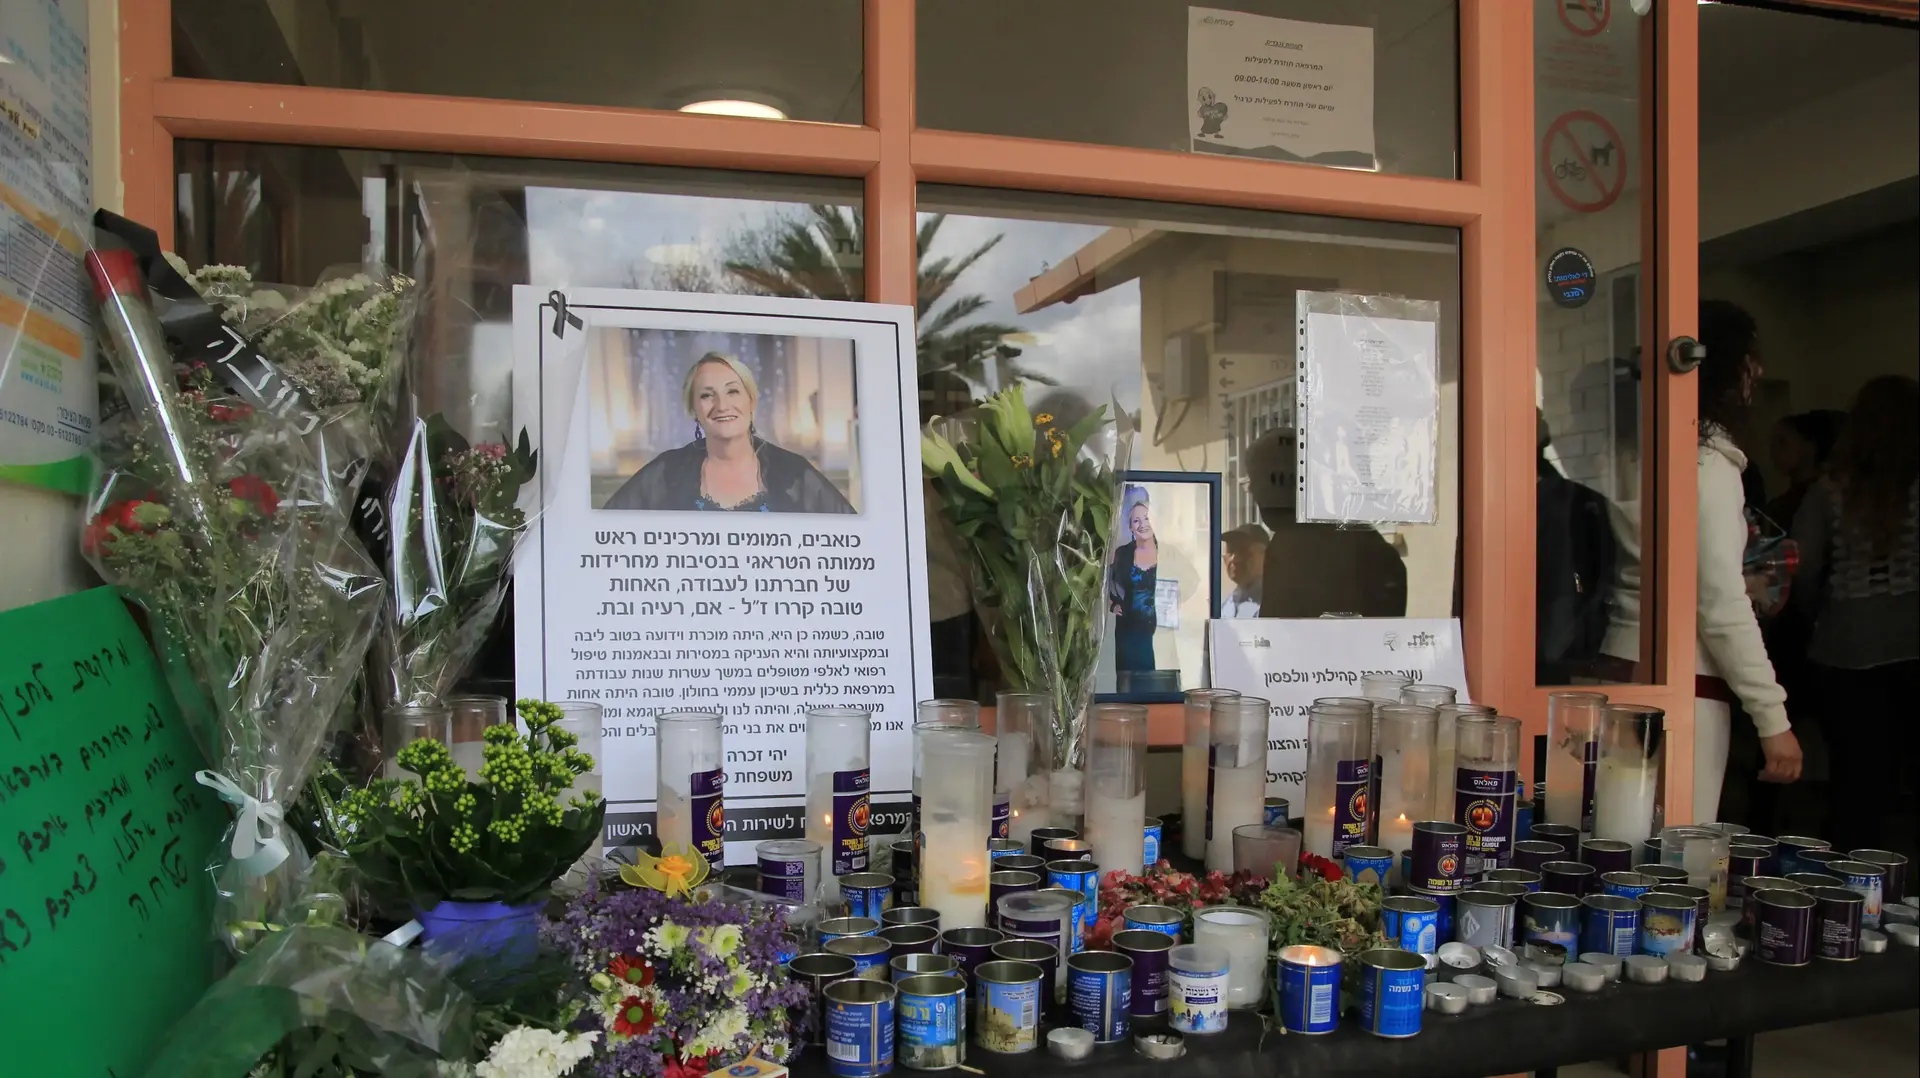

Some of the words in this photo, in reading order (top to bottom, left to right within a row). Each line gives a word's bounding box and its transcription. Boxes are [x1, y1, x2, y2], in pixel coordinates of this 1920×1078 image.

[1245, 55, 1272, 65] לפעילות
[1274, 59, 1294, 67] חוזרת
[1295, 62, 1323, 71] המרפאה
[1234, 74, 1280, 86] 09:00-14:00
[1281, 80, 1301, 88] משעה
[1303, 82, 1322, 91] ראשון
[1254, 96, 1282, 105] לפעילות
[596, 531, 636, 544] ראש
[644, 532, 720, 545] ומרכינים
[728, 533, 791, 546] המומים
[798, 534, 860, 548] כואבים,
[580, 555, 658, 568] מחרידות
[666, 555, 739, 568] בנסיבות
[747, 556, 810, 569] הטראגי
[818, 557, 875, 570] ממותה
[609, 578, 669, 591] האחות
[677, 575, 747, 594] לעבודה,
[755, 579, 818, 592] חברתנו
[825, 575, 850, 592] של
[597, 602, 633, 615] ובת.
[642, 602, 684, 615] רעיה
[691, 602, 722, 617] אם,
[775, 602, 814, 619] קררו
[821, 602, 862, 615] טובה
[575, 629, 604, 641] ליבה
[610, 631, 641, 641] בטוב
[646, 631, 683, 640] וידועה
[689, 631, 728, 640] מוכרת
[733, 631, 764, 640] היתה
[768, 631, 792, 641] היא,
[797, 631, 808, 643] כן
[813, 631, 848, 640] כשמה
[853, 631, 884, 641] טובה,
[571, 648, 607, 660] טיפול
[612, 650, 671, 660] ובנאמנות
[676, 650, 730, 659] במסירות
[735, 649, 779, 661] העניקה
[785, 649, 809, 658] והיא
[814, 649, 888, 660] ובמקצועיותה
[576, 670, 626, 680] עבודתה
[632, 669, 663, 679] שנות
[668, 669, 710, 678] עשרות
[715, 668, 752, 680] במשך
[757, 665, 809, 677] מטופלים
[814, 664, 849, 676] לאלפי
[854, 667, 885, 676] רפואי
[1264, 669, 1309, 689] וולפסון
[1312, 669, 1358, 686] קהילתי
[567, 689, 600, 699] אחות
[605, 689, 637, 698] היתה
[643, 688, 674, 698] טובה
[679, 685, 719, 700] בחולון.
[724, 687, 755, 696] עממי
[761, 686, 798, 698] בשיכון
[804, 683, 839, 695] כללית
[843, 685, 895, 694] במרפאת
[626, 706, 665, 717] דוגמא
[732, 702, 750, 715] לנו
[755, 704, 789, 715] והיתה
[626, 723, 656, 737] בלים
[743, 724, 761, 734] בני
[766, 723, 784, 733] את
[886, 721, 904, 731] אנו
[1267, 738, 1300, 751] והצוו
[727, 750, 763, 762] זכרה
[768, 749, 788, 762] יהי
[735, 770, 793, 784] משפחת
[1473, 779, 1498, 787] פאלאס
[742, 815, 795, 832] לשירות
[607, 821, 653, 841] ראשון
[1185, 987, 1209, 996] נשמה
[1211, 987, 1219, 995] נר
[1388, 984, 1412, 993] נשמה
[1412, 983, 1420, 991] נר
